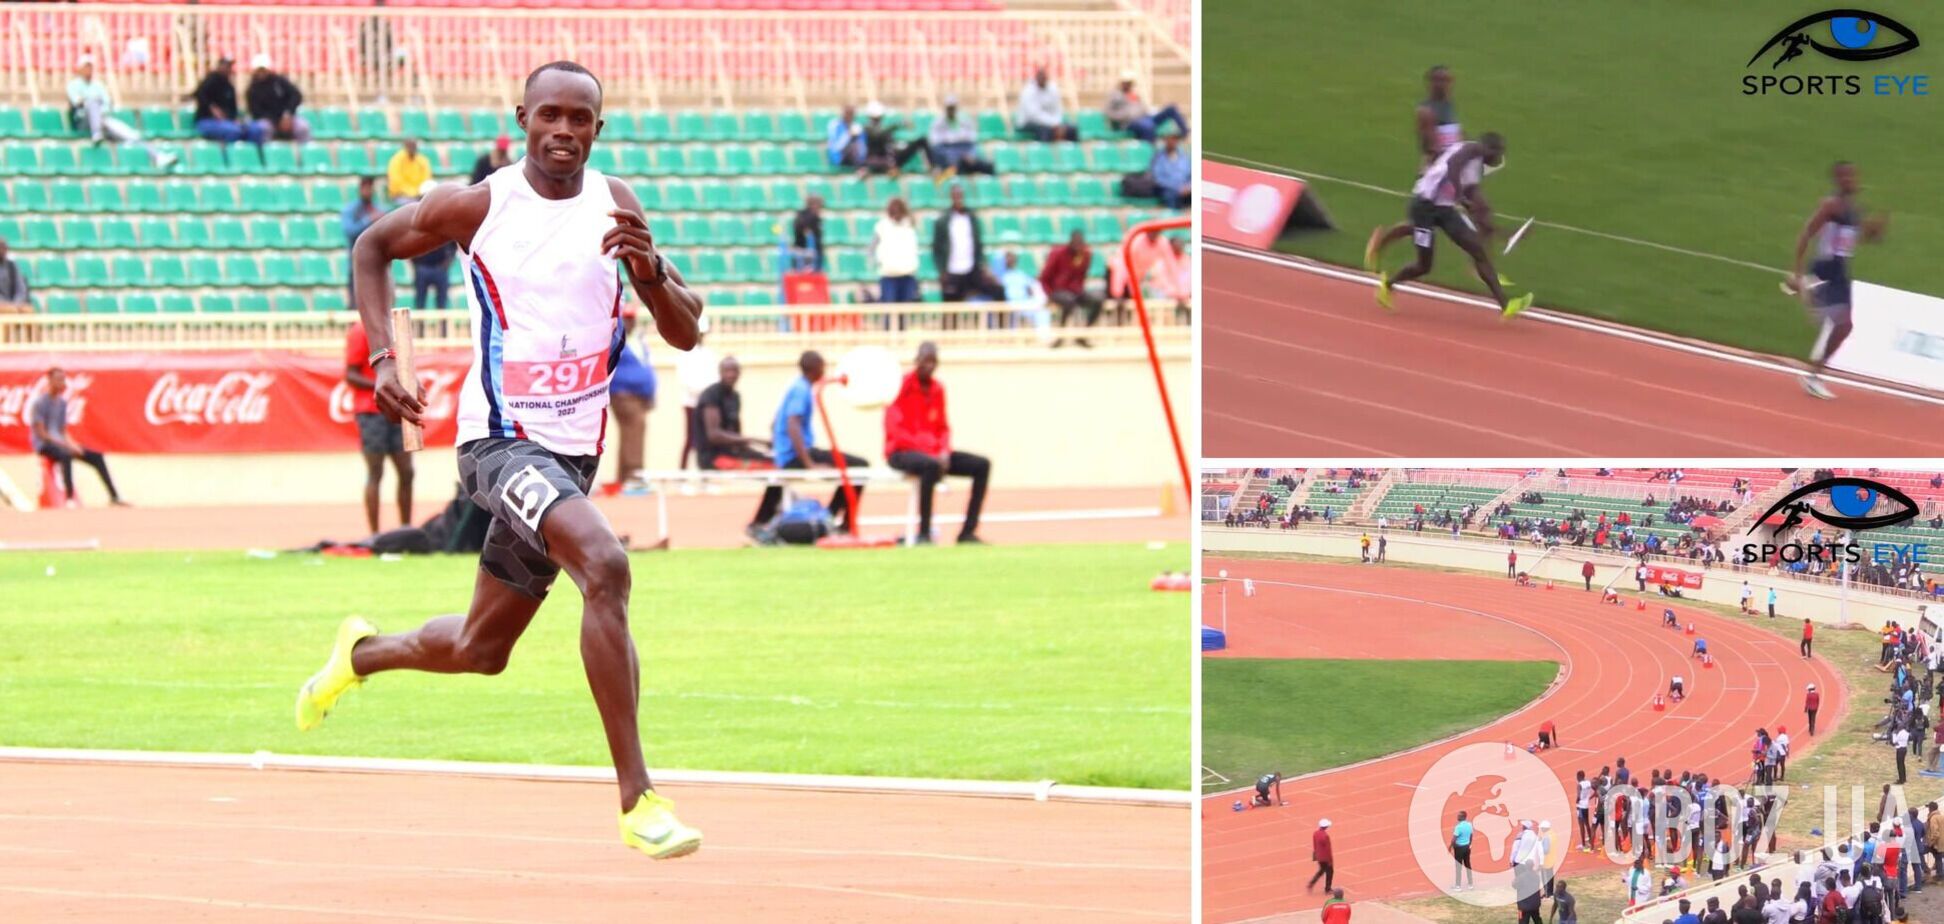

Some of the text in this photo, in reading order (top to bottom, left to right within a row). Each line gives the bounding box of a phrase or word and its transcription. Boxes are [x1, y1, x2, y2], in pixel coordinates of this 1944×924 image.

[528, 356, 599, 394] 297
[144, 371, 276, 426] Coca-Cola
[508, 400, 553, 410] NATIONAL
[557, 407, 576, 417] 2023
[506, 470, 549, 521] 5
